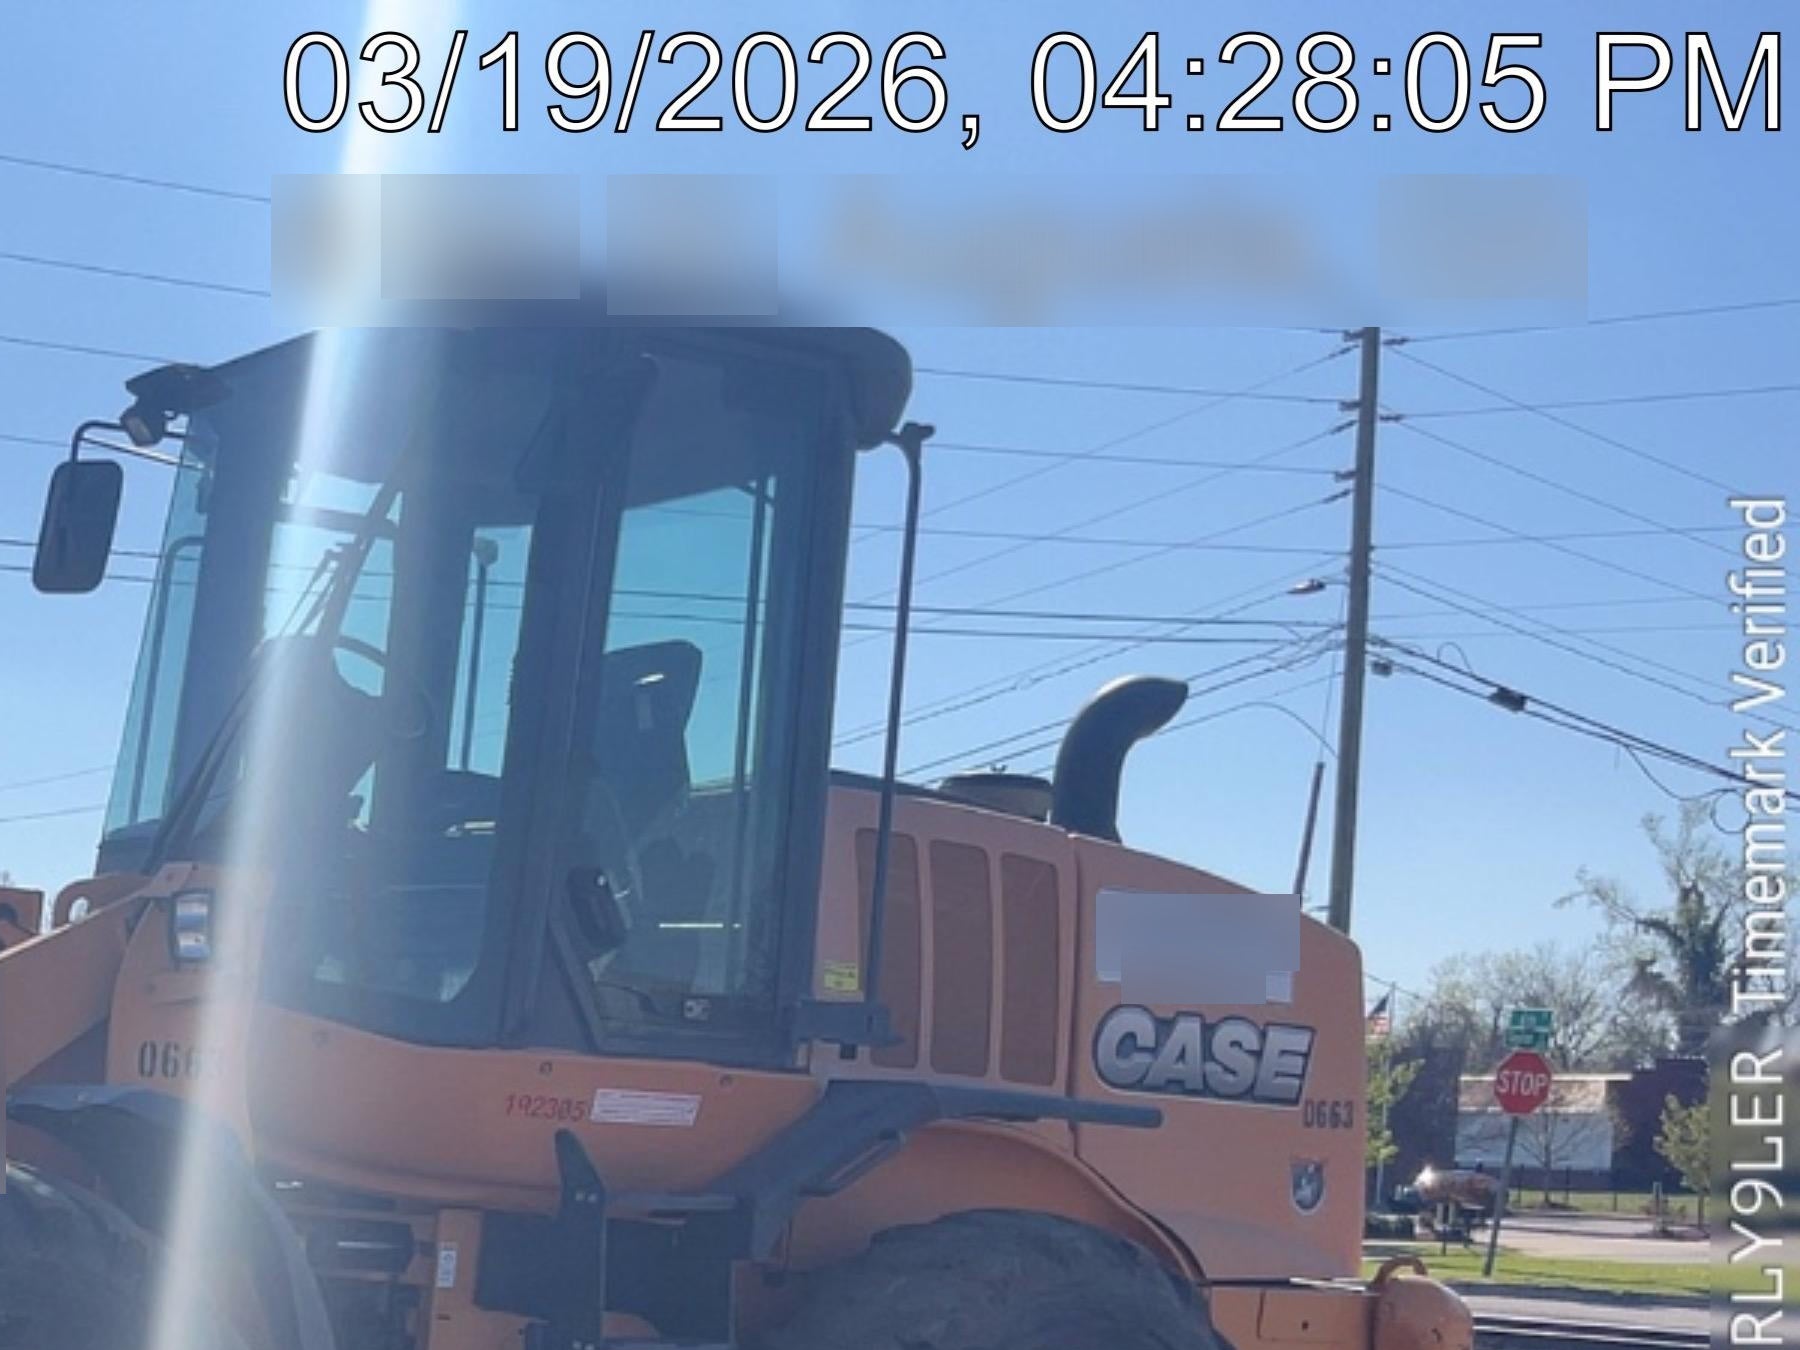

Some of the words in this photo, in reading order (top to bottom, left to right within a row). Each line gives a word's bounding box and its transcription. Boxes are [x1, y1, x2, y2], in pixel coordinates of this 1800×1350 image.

[1095, 1004, 1313, 1105] CASE
[1497, 1070, 1548, 1096] STOP
[1303, 1100, 1354, 1128] 0663
